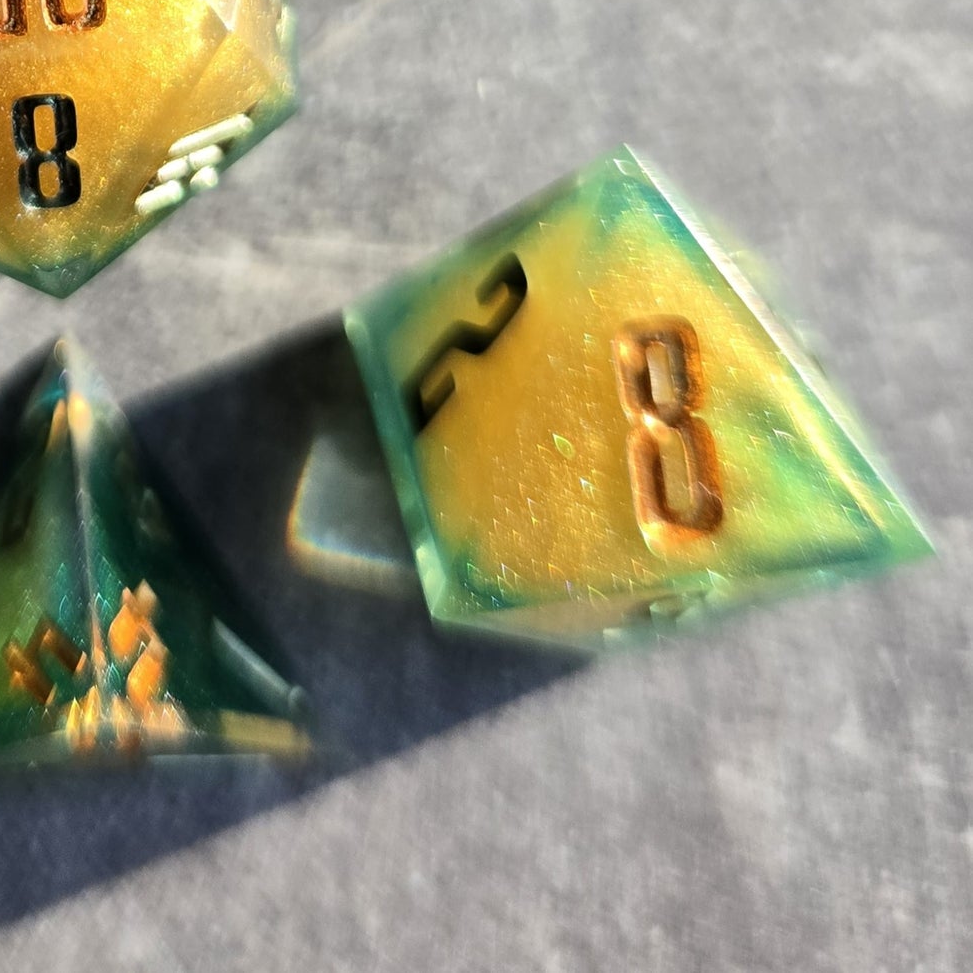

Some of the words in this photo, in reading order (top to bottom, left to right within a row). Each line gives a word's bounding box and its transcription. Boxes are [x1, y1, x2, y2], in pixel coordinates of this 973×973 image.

[10, 92, 83, 209] 8
[400, 250, 529, 439] 2
[610, 312, 725, 549] 8
